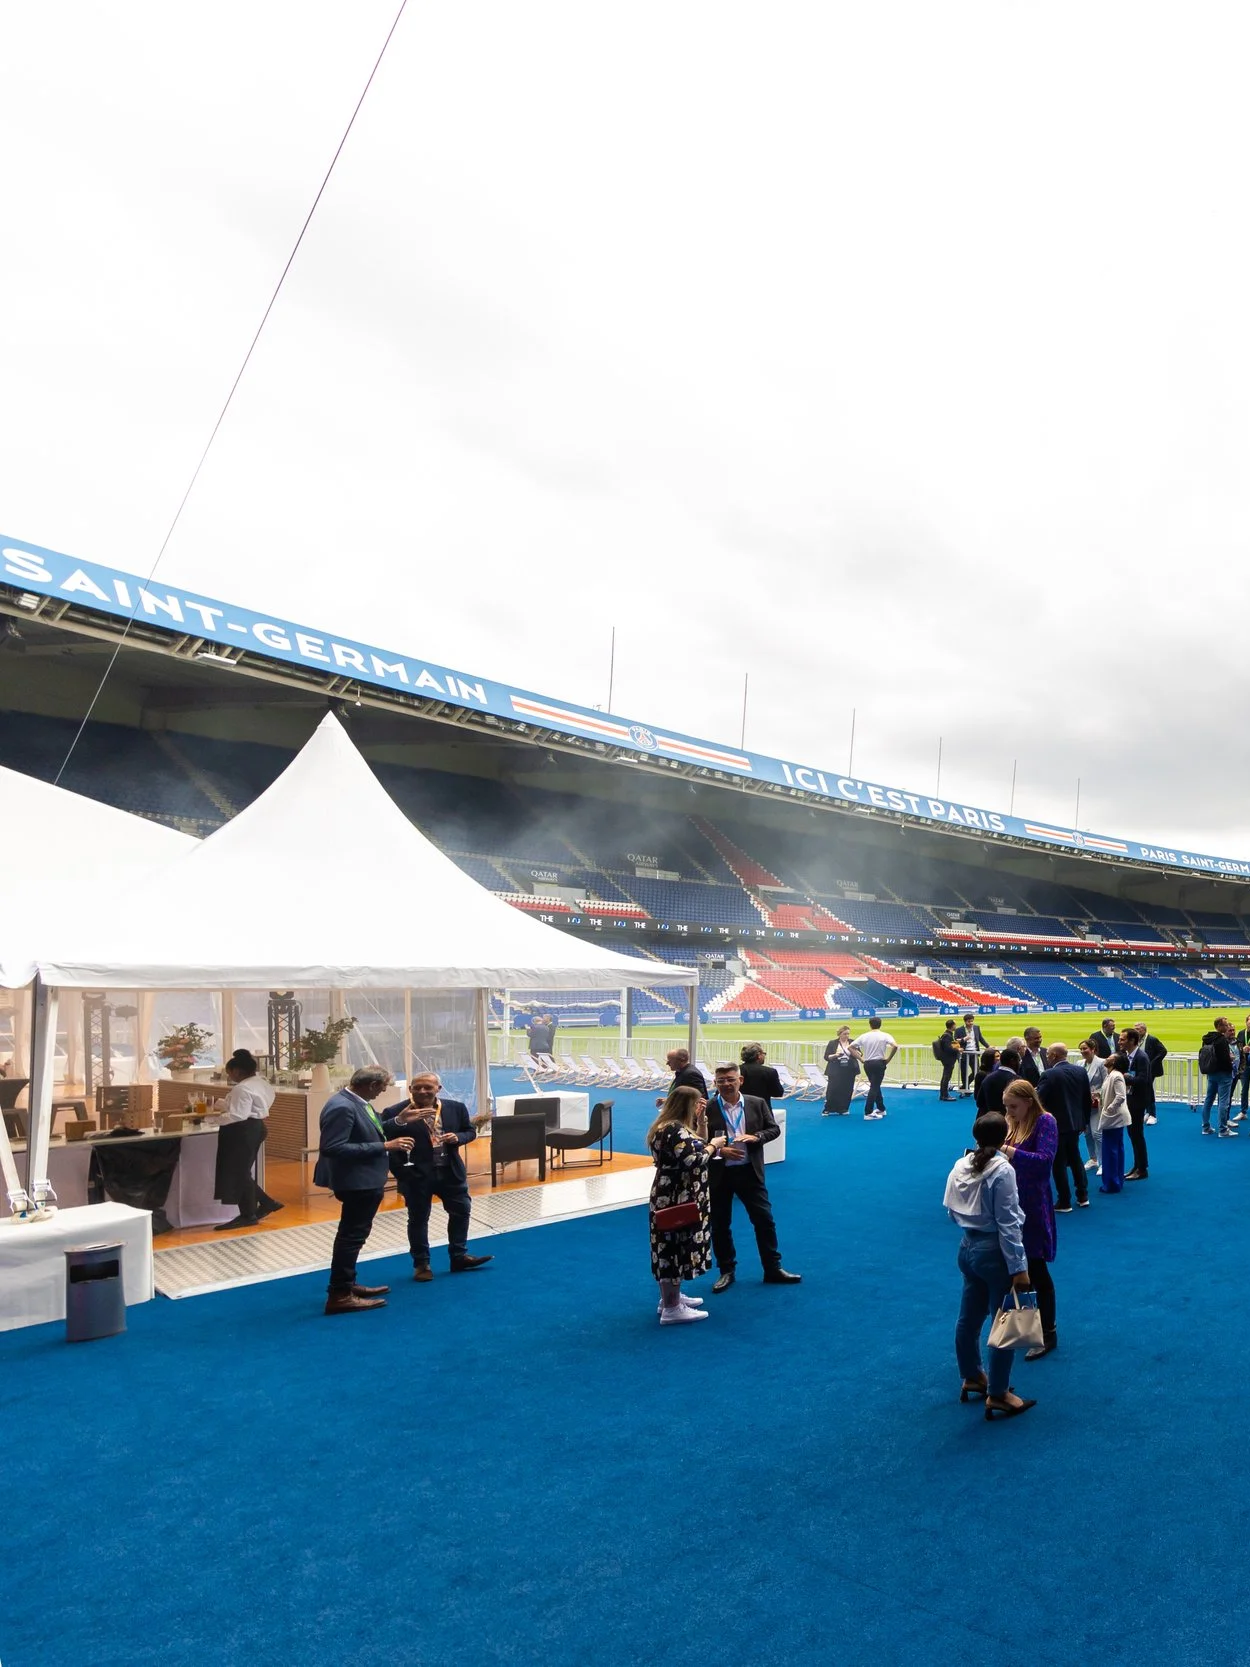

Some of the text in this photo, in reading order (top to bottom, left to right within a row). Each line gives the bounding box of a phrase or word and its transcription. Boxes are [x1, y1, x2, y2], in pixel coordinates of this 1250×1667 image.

[2, 548, 488, 705] SAINT-GERMAIN
[782, 763, 1006, 832] ICI C'EST PARIS
[627, 853, 658, 864] QATAR
[1140, 847, 1177, 862] PARIS
[531, 870, 558, 879] QATAR
